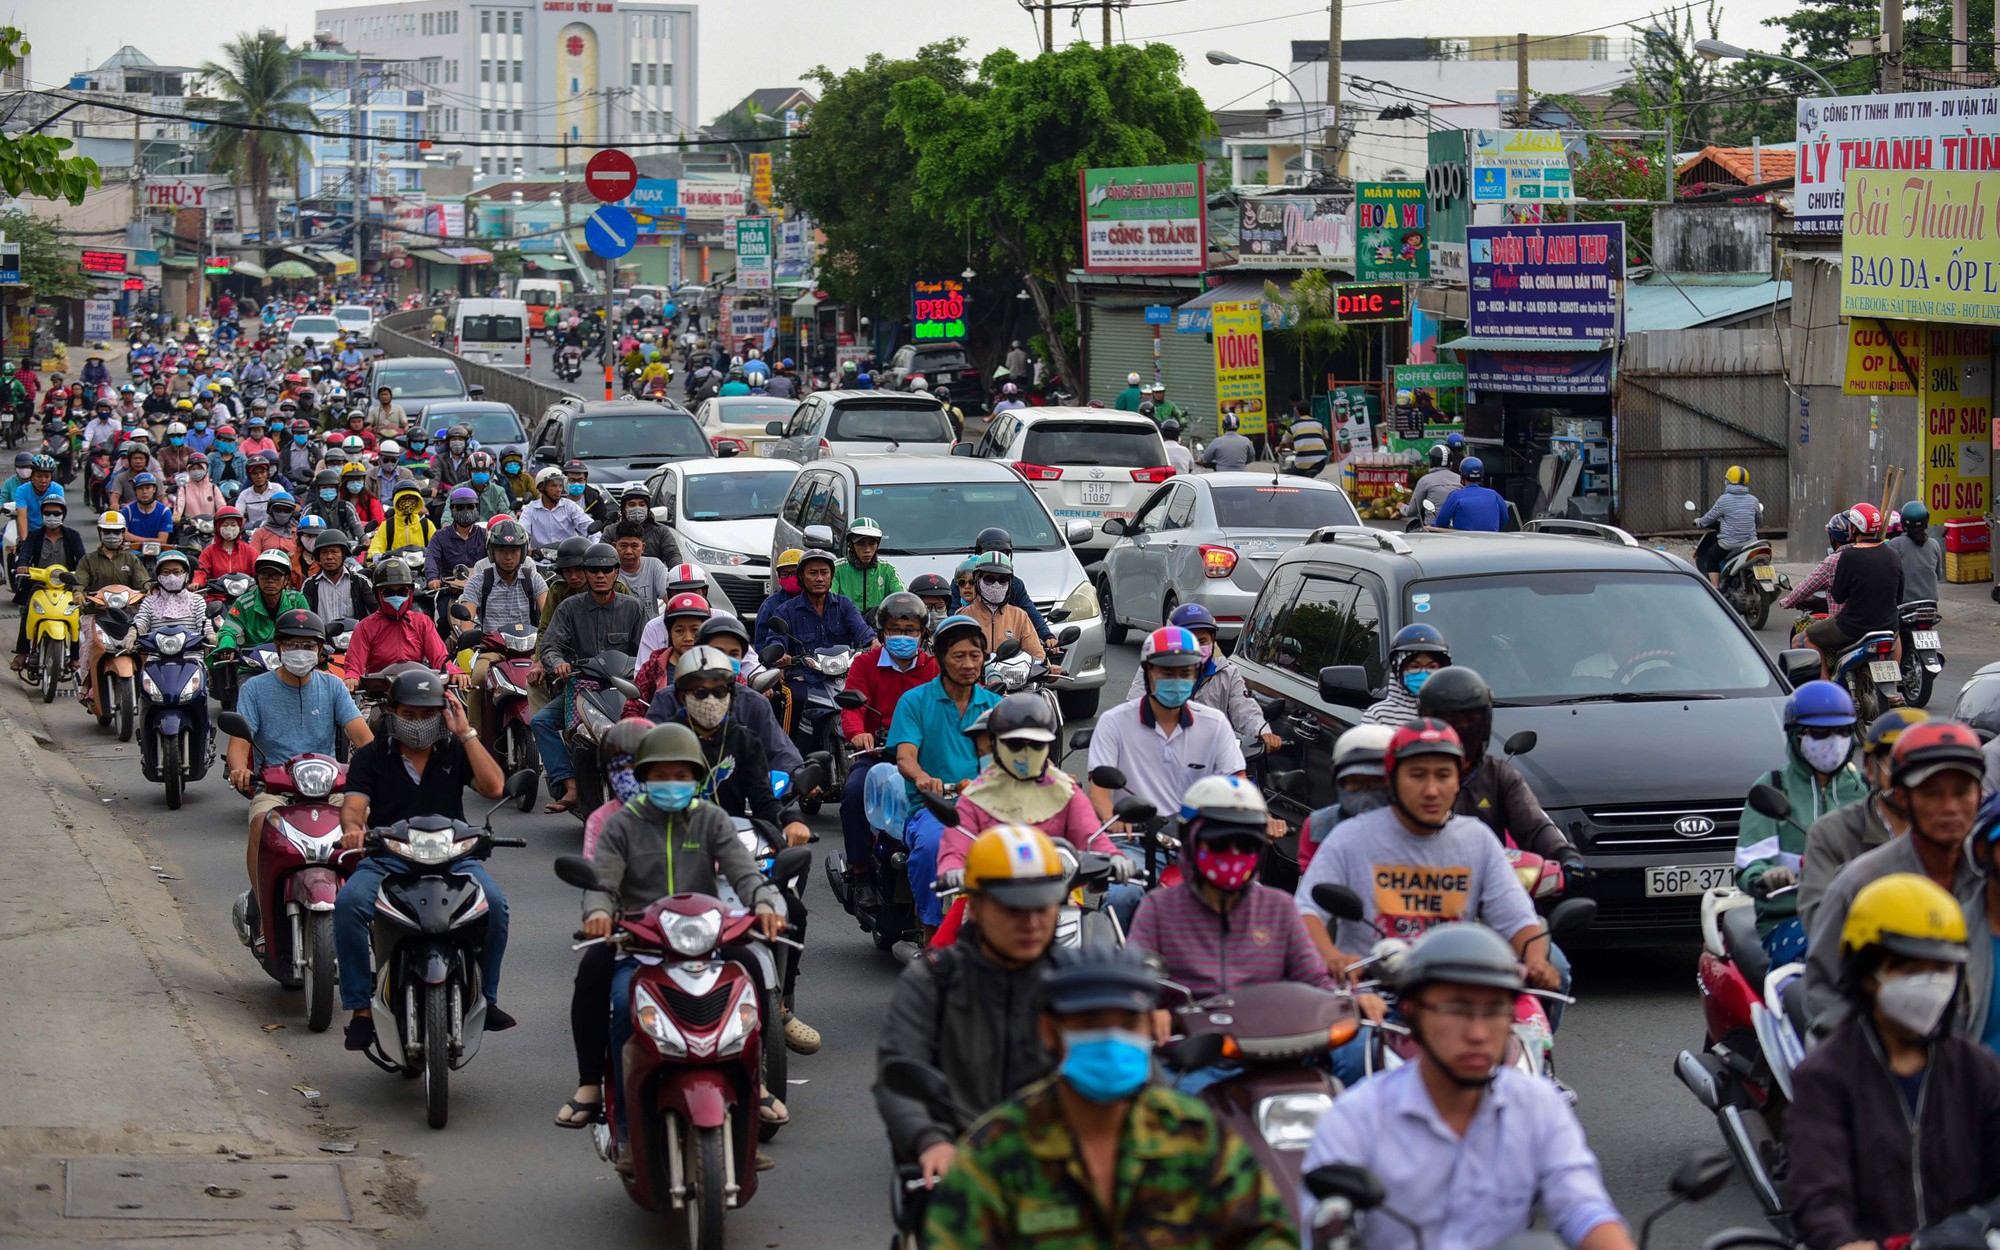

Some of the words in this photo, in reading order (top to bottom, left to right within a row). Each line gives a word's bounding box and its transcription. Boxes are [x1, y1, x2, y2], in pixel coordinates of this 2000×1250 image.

[1823, 103, 1848, 122] CÔNG
[1851, 105, 1862, 121] TY
[1865, 103, 1889, 120] TNHH
[1894, 101, 1915, 119] MTV
[1918, 101, 1932, 118] TM
[1941, 99, 1955, 117] DV
[1957, 96, 1979, 120] VẬN
[1982, 92, 1997, 115] TẢI
[1799, 132, 1831, 184] LÝ
[1837, 136, 1933, 178] THANH
[635, 189, 663, 201] INAX
[1152, 183, 1175, 199] NAM
[1176, 182, 1196, 198] KIM
[1364, 185, 1394, 198] MẦM
[1397, 188, 1421, 198] NON
[1359, 203, 1398, 234] HỌA
[1402, 203, 1425, 229] MI
[1849, 176, 1890, 237] Sài
[1901, 177, 1986, 241] Thành
[740, 228, 765, 243] HÒA
[1108, 222, 1145, 245] CÔNG
[1148, 219, 1198, 244] THÀNH
[740, 243, 766, 255] BÌNH
[1546, 235, 1577, 265] ANH
[1850, 255, 1894, 287] BAO
[1900, 258, 1929, 290] DA
[1947, 246, 1977, 292] ỐP
[1983, 261, 2000, 293] L
[1556, 275, 1574, 290] MUA
[1592, 275, 1607, 289] TIVI
[915, 290, 964, 320] PHỞ
[1845, 296, 1889, 311] FACEBOOK:
[1906, 297, 1934, 316] THÀNH
[1935, 301, 1956, 317] CASE
[1962, 304, 1980, 319] HOT
[1217, 328, 1260, 371] VÕNG
[1854, 330, 1908, 347] CUOG
[1930, 330, 1949, 357] TAI
[1953, 329, 1988, 356] NGHE
[1397, 372, 1431, 381] COFFEE
[1433, 371, 1463, 380] QUEEN
[1932, 367, 1958, 392] 30k
[1930, 402, 1955, 435] CÁP
[1960, 407, 1986, 440] SẠC
[1930, 444, 1955, 468] 40k
[1088, 483, 1104, 493] 51H
[1932, 474, 1950, 511] CỦ
[1955, 482, 1983, 515] SẠC
[1054, 509, 1080, 518] GREEN
[1081, 510, 1101, 518] LEAF
[1679, 819, 1709, 833] KIA
[1376, 872, 1470, 891] CHANGE
[1400, 893, 1442, 912] THE
